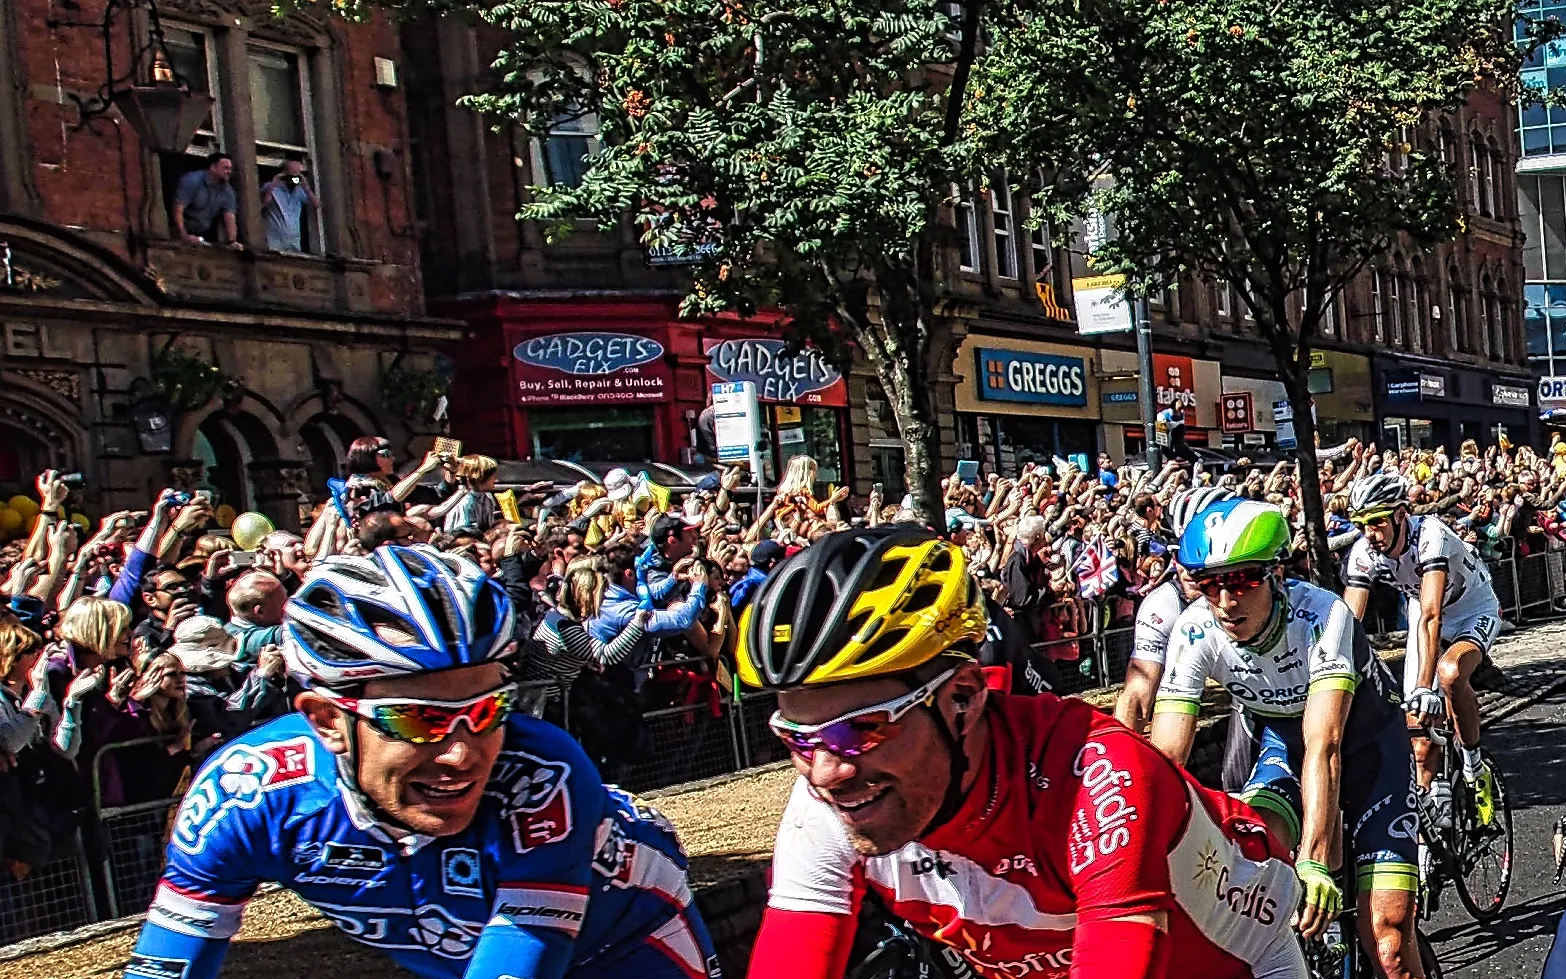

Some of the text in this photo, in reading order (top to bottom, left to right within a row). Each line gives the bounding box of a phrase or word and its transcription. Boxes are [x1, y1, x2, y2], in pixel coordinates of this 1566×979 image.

[526, 337, 650, 361] GADGETS
[575, 379, 612, 389] Repair
[614, 379, 622, 387] &
[625, 377, 664, 387] Unlock
[764, 377, 799, 402] FIX
[1008, 360, 1083, 396] GREGGS
[1072, 740, 1138, 857] Cofidis
